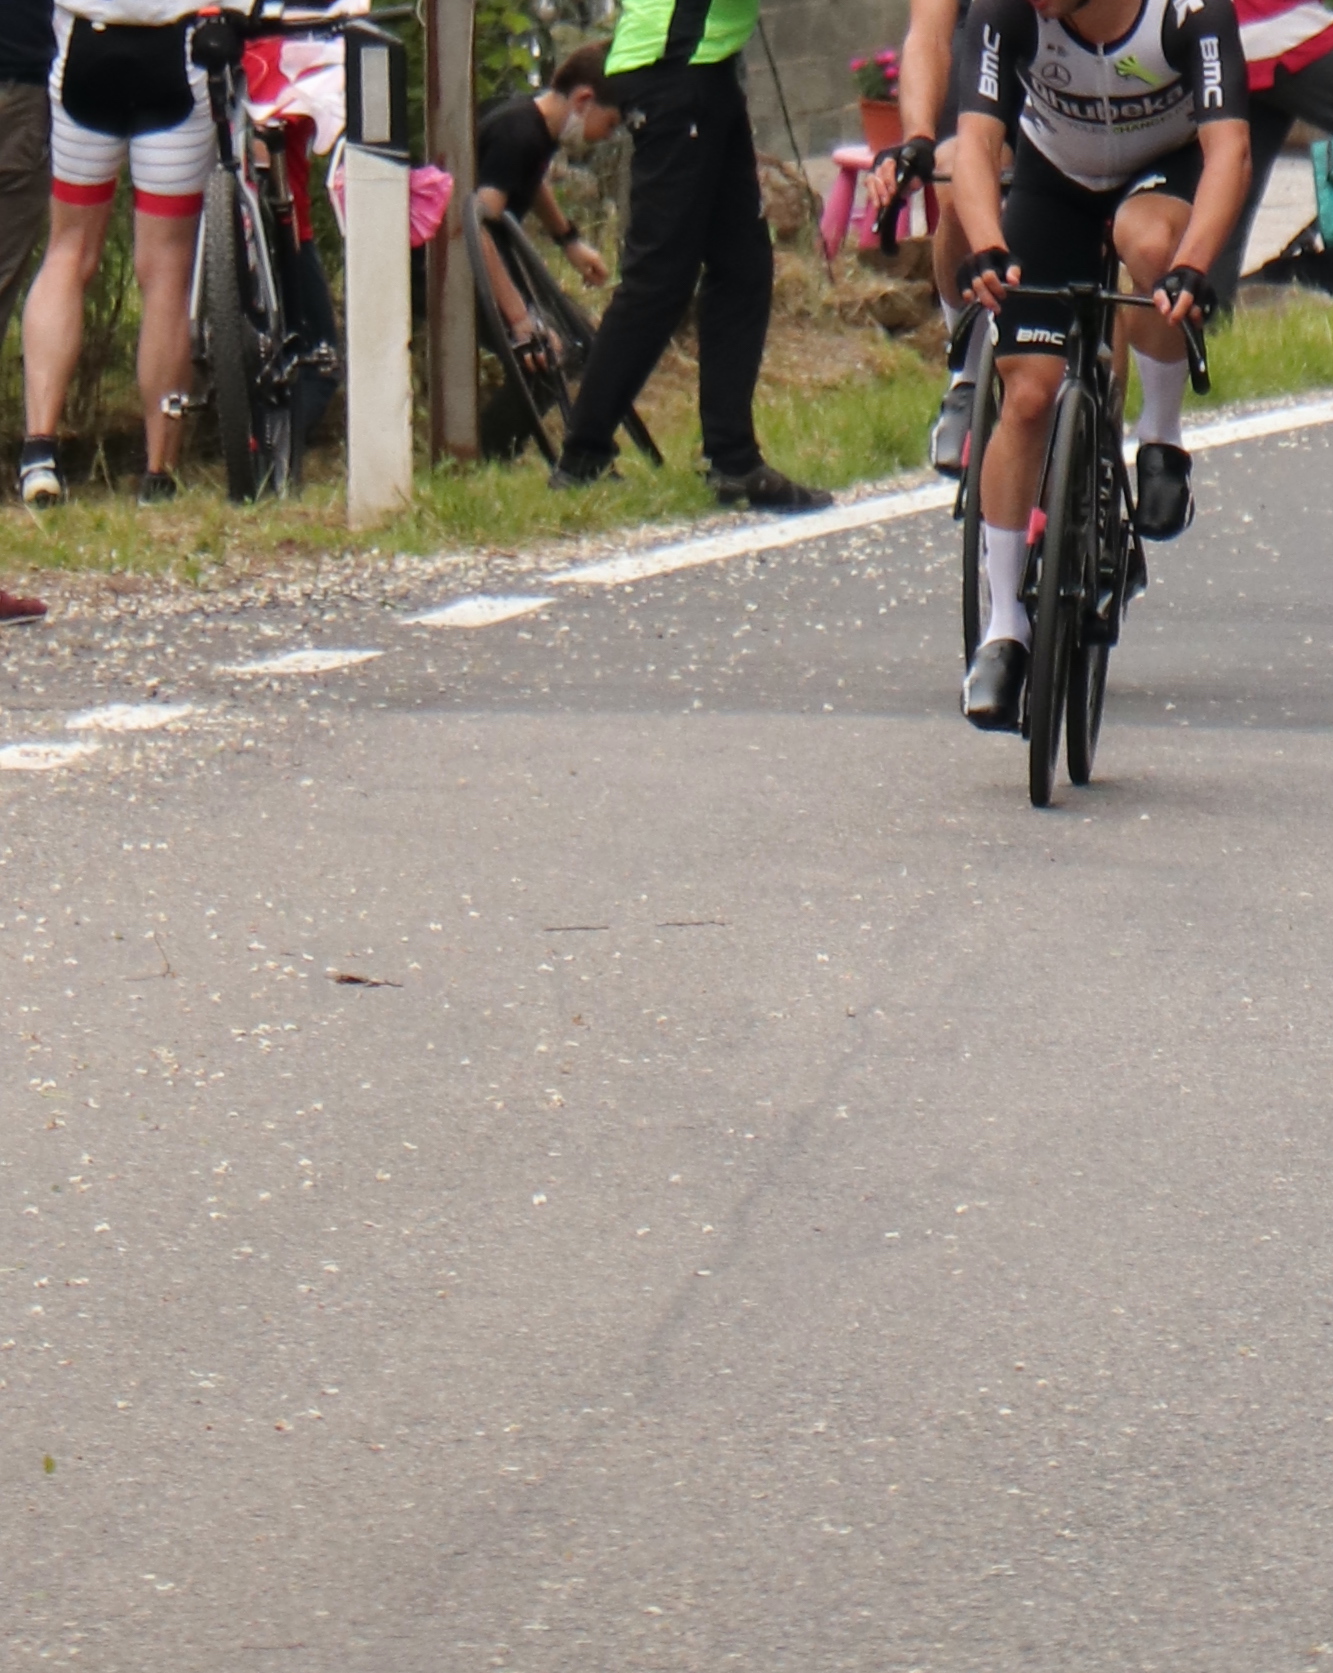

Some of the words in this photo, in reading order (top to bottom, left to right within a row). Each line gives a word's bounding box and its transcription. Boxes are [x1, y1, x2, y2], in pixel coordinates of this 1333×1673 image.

[978, 23, 1001, 102] BMC
[1199, 35, 1223, 109] BMC
[1016, 327, 1066, 346] BMC
